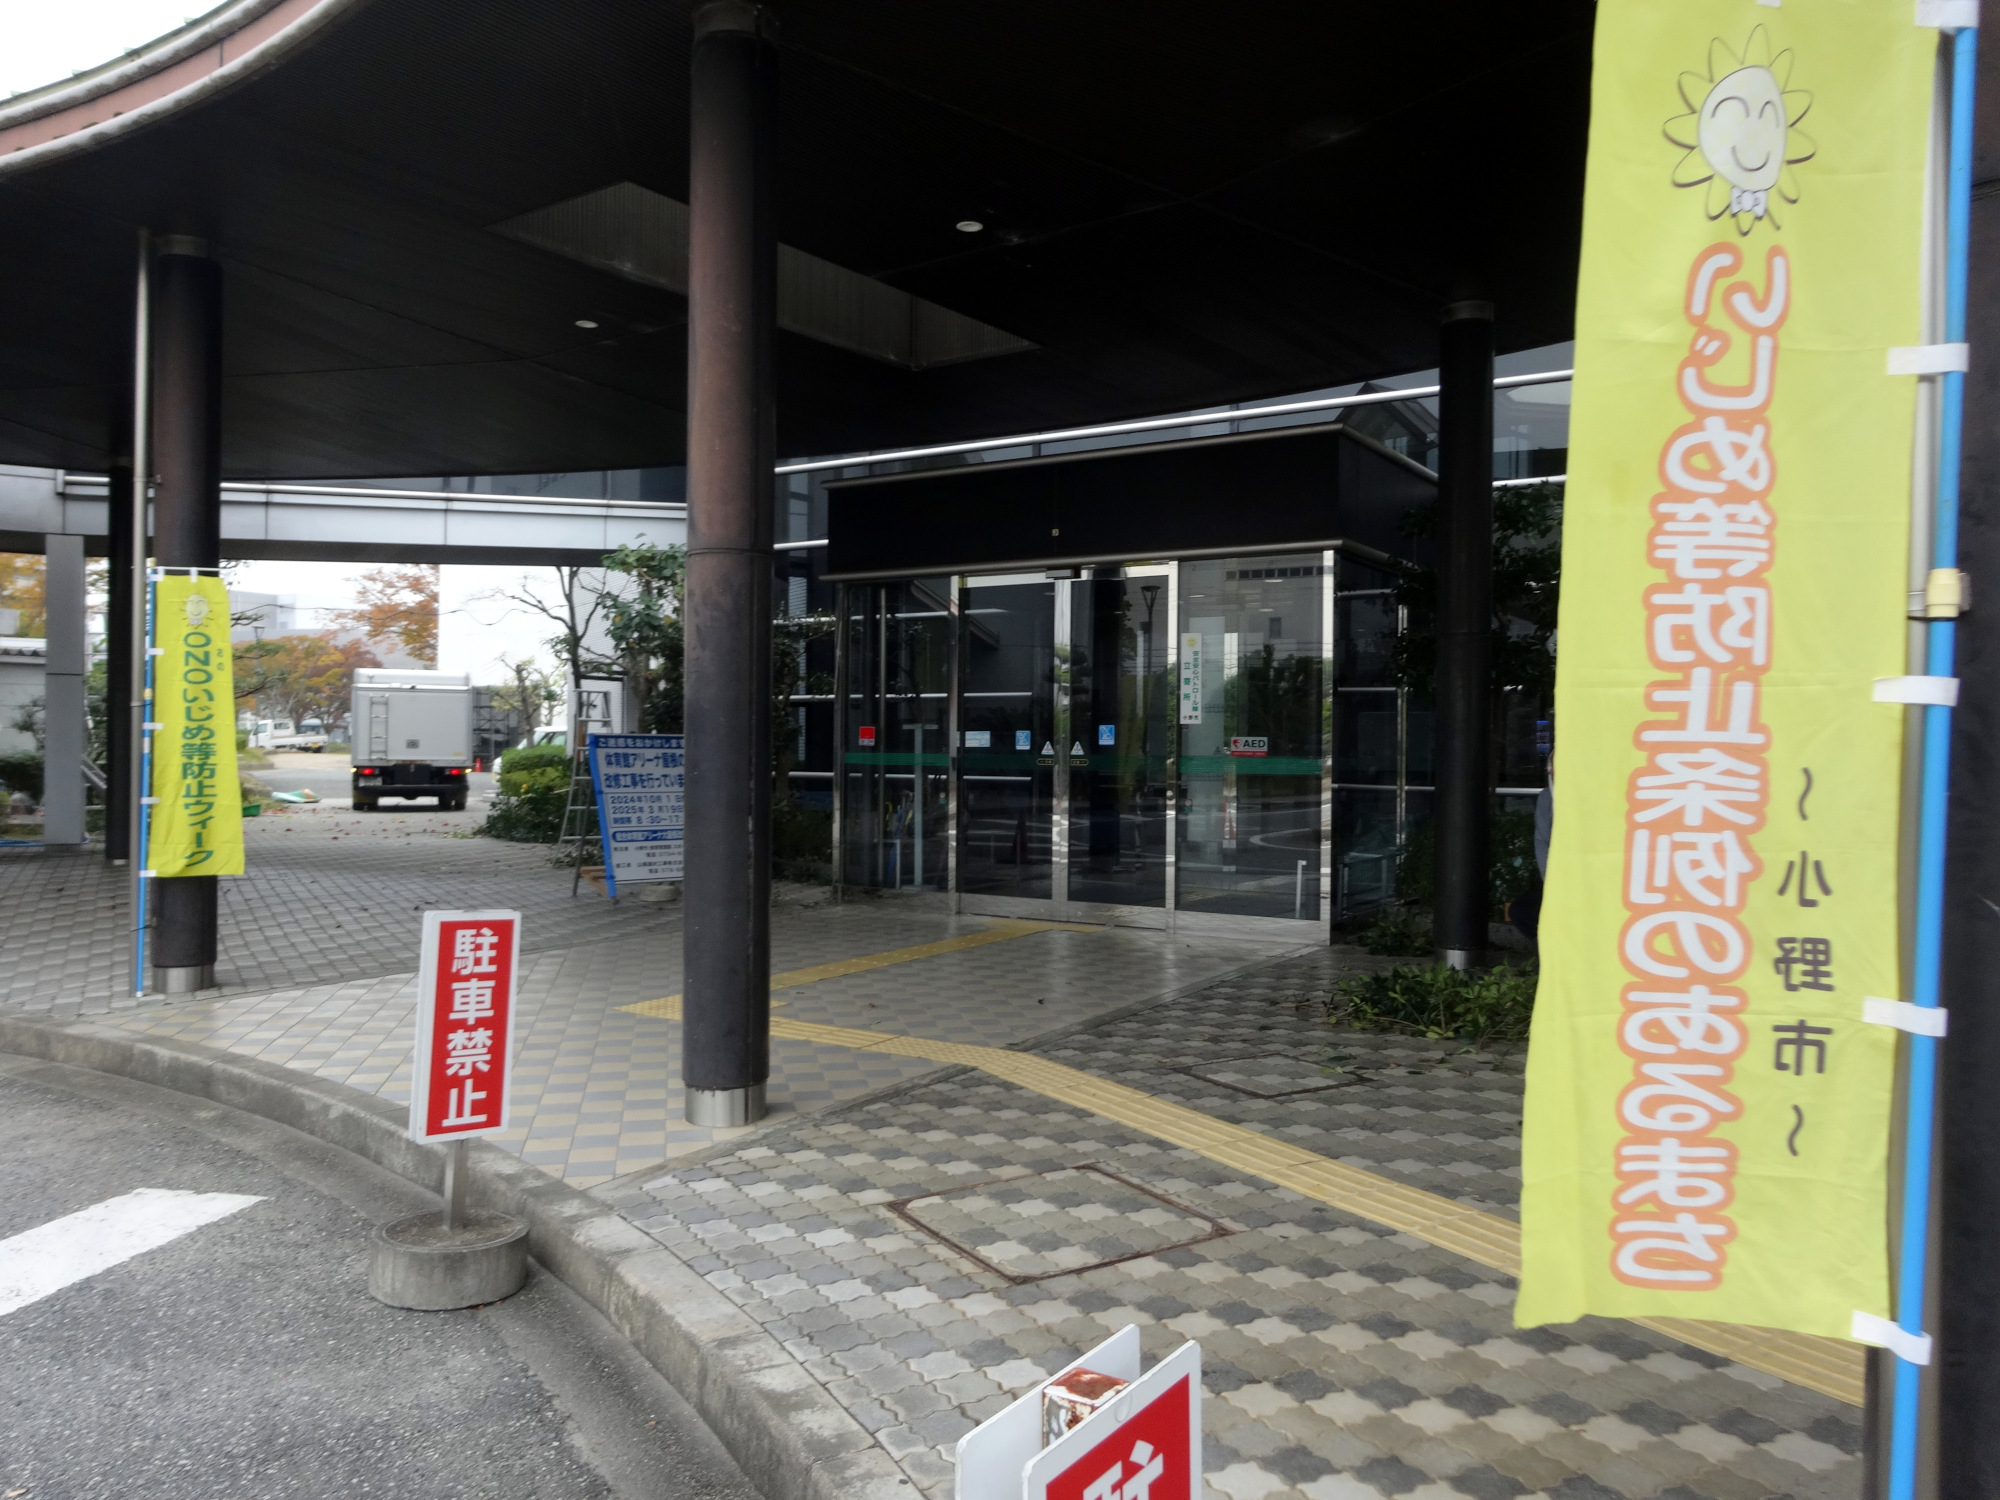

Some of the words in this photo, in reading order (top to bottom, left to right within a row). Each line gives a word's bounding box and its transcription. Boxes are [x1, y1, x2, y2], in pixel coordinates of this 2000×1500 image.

[181, 631, 217, 868] ONOいじめ等防止ウィーク
[1243, 739, 1266, 748] AED
[441, 927, 499, 1128] 駐車禁止
